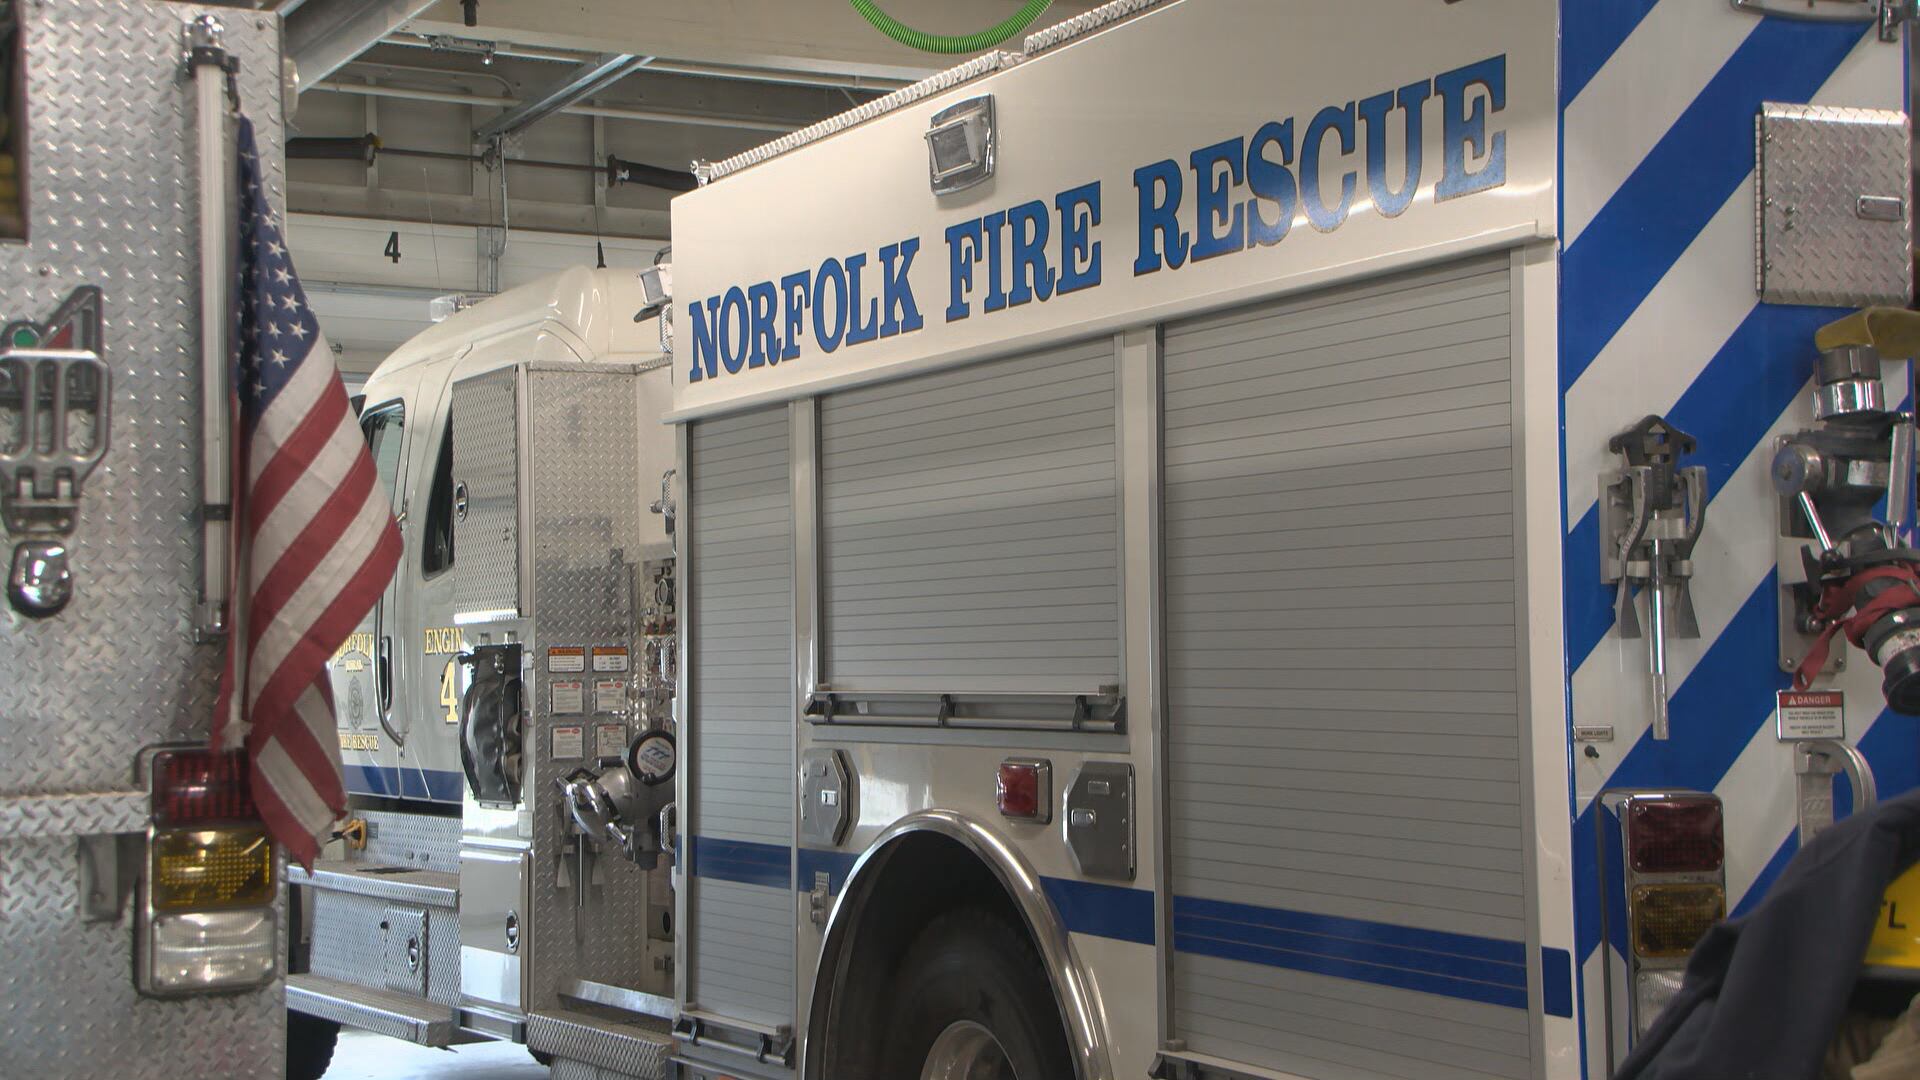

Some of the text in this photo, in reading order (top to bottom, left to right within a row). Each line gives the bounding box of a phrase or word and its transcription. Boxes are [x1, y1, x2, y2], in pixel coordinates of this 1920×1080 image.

[688, 54, 1506, 380] NORFOLK FIRE RESCUE
[384, 231, 401, 264] 4
[333, 633, 374, 668] ORFOL
[425, 628, 464, 655] ENGIN
[440, 661, 459, 725] 4
[1797, 695, 1831, 705] DANGER
[352, 733, 379, 751] RESCUE
